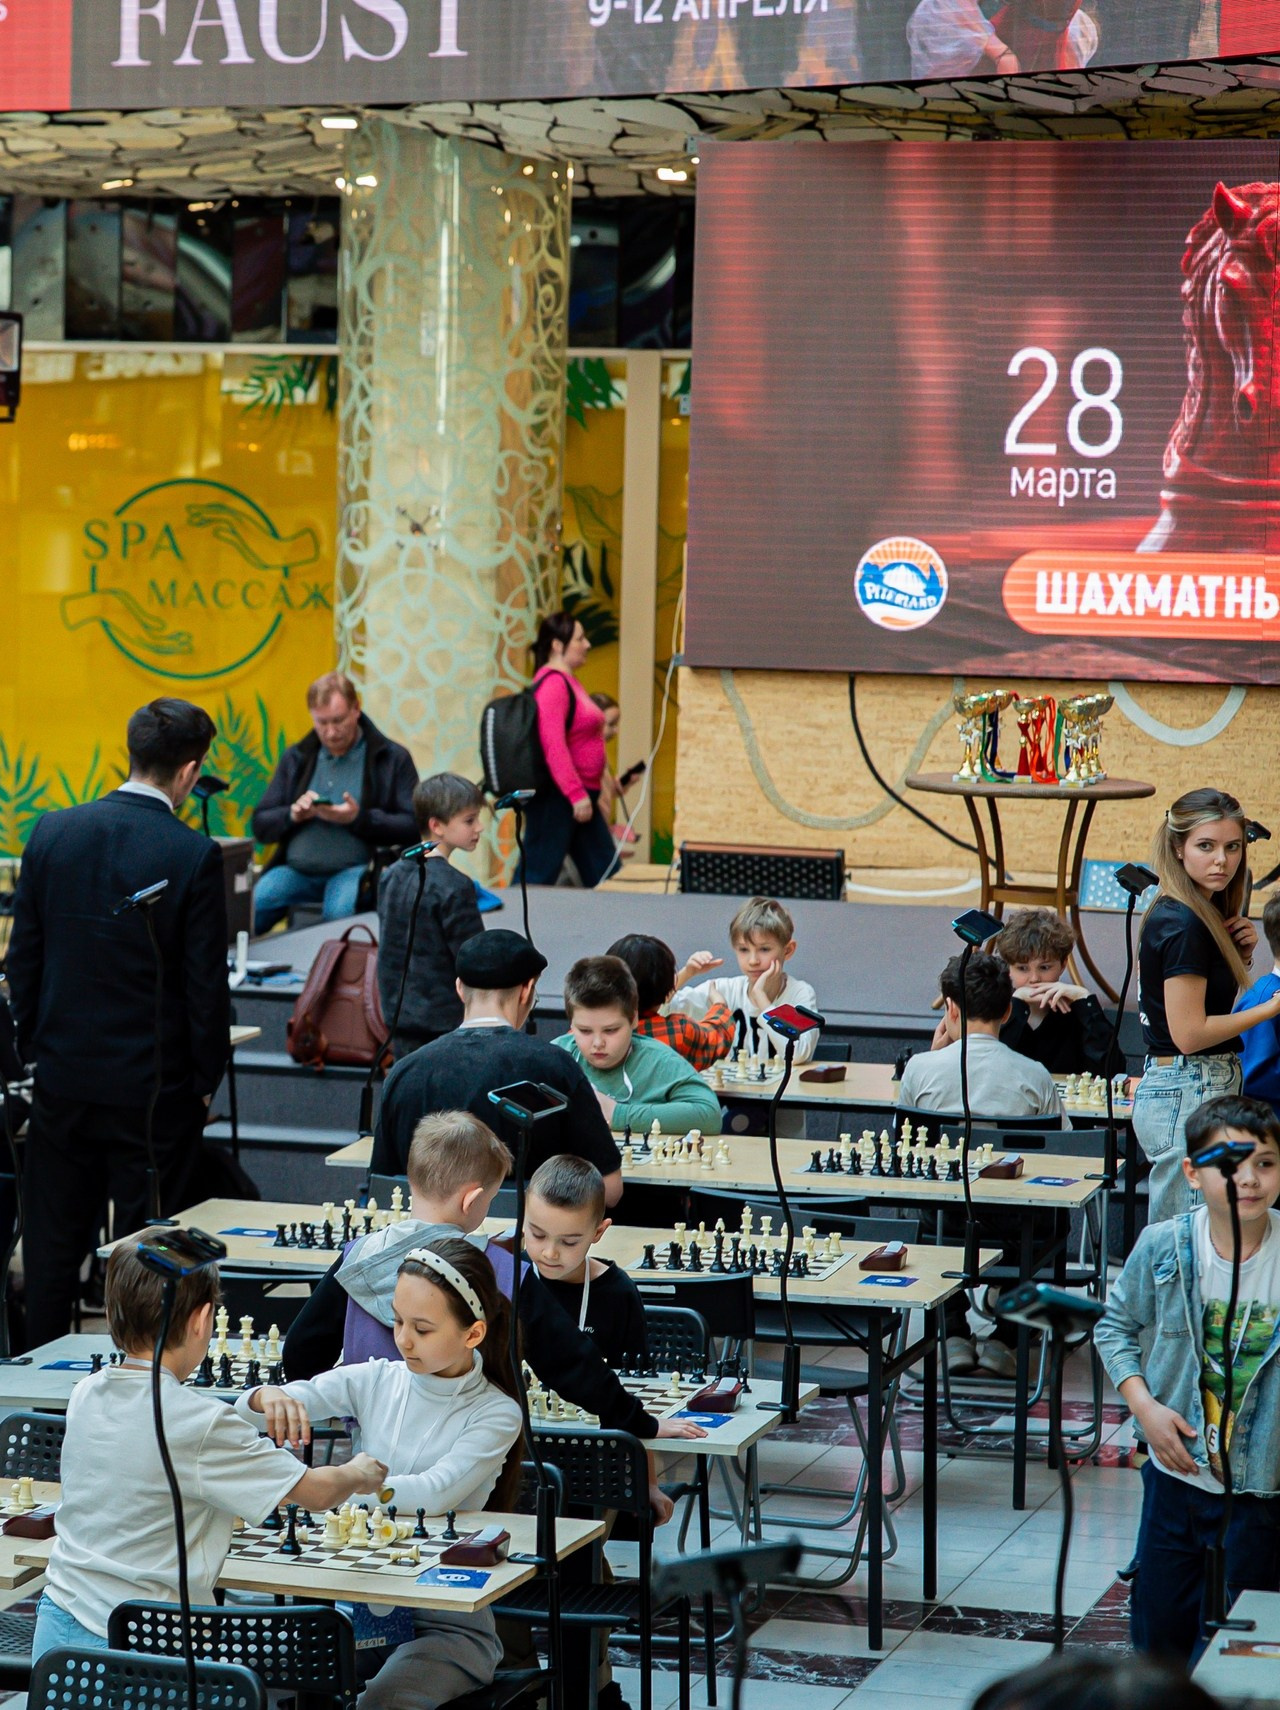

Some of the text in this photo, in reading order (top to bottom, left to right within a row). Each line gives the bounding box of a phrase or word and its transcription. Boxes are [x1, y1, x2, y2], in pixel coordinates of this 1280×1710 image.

[588, 0, 664, 27] 9-12
[1004, 345, 1124, 459] 28
[1010, 466, 1117, 507] марта
[83, 519, 185, 562] SPA
[148, 578, 334, 611] МАССАЖ
